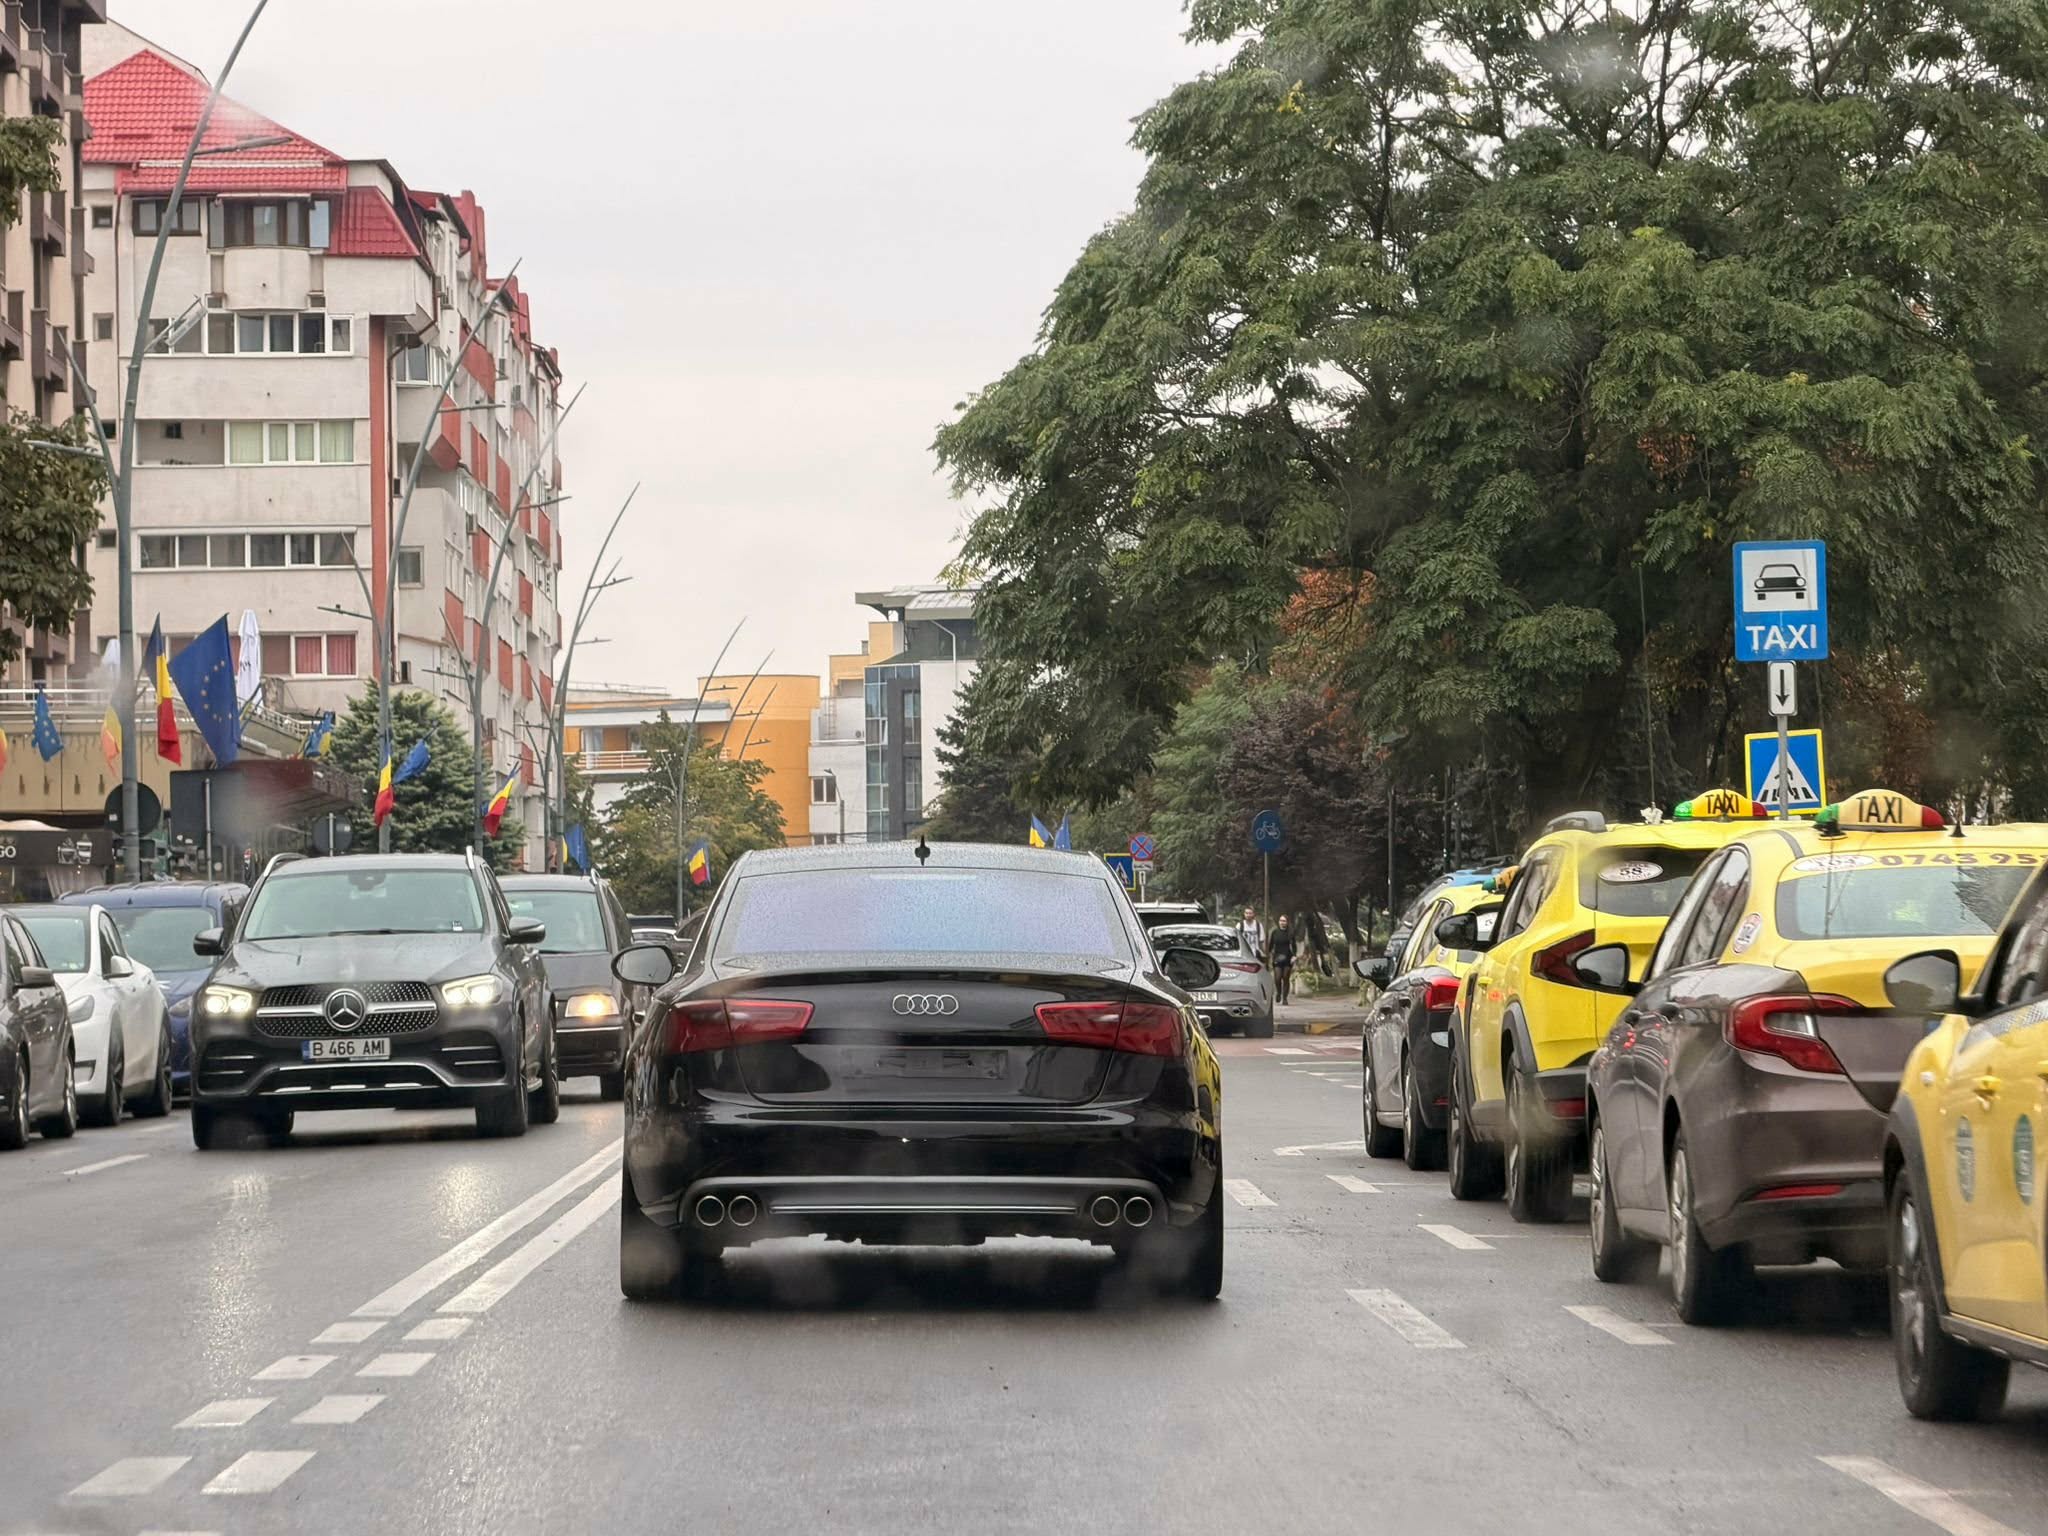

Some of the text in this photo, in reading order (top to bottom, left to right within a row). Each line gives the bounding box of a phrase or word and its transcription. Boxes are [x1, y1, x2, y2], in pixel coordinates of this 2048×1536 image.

[1745, 623, 1817, 651] TAXI
[1705, 794, 1740, 815] TAXI
[1855, 795, 1904, 824] TAXI
[1879, 853, 1979, 866] 0743
[1989, 853, 2048, 865] 95
[312, 1040, 385, 1056] B 466 AMI
